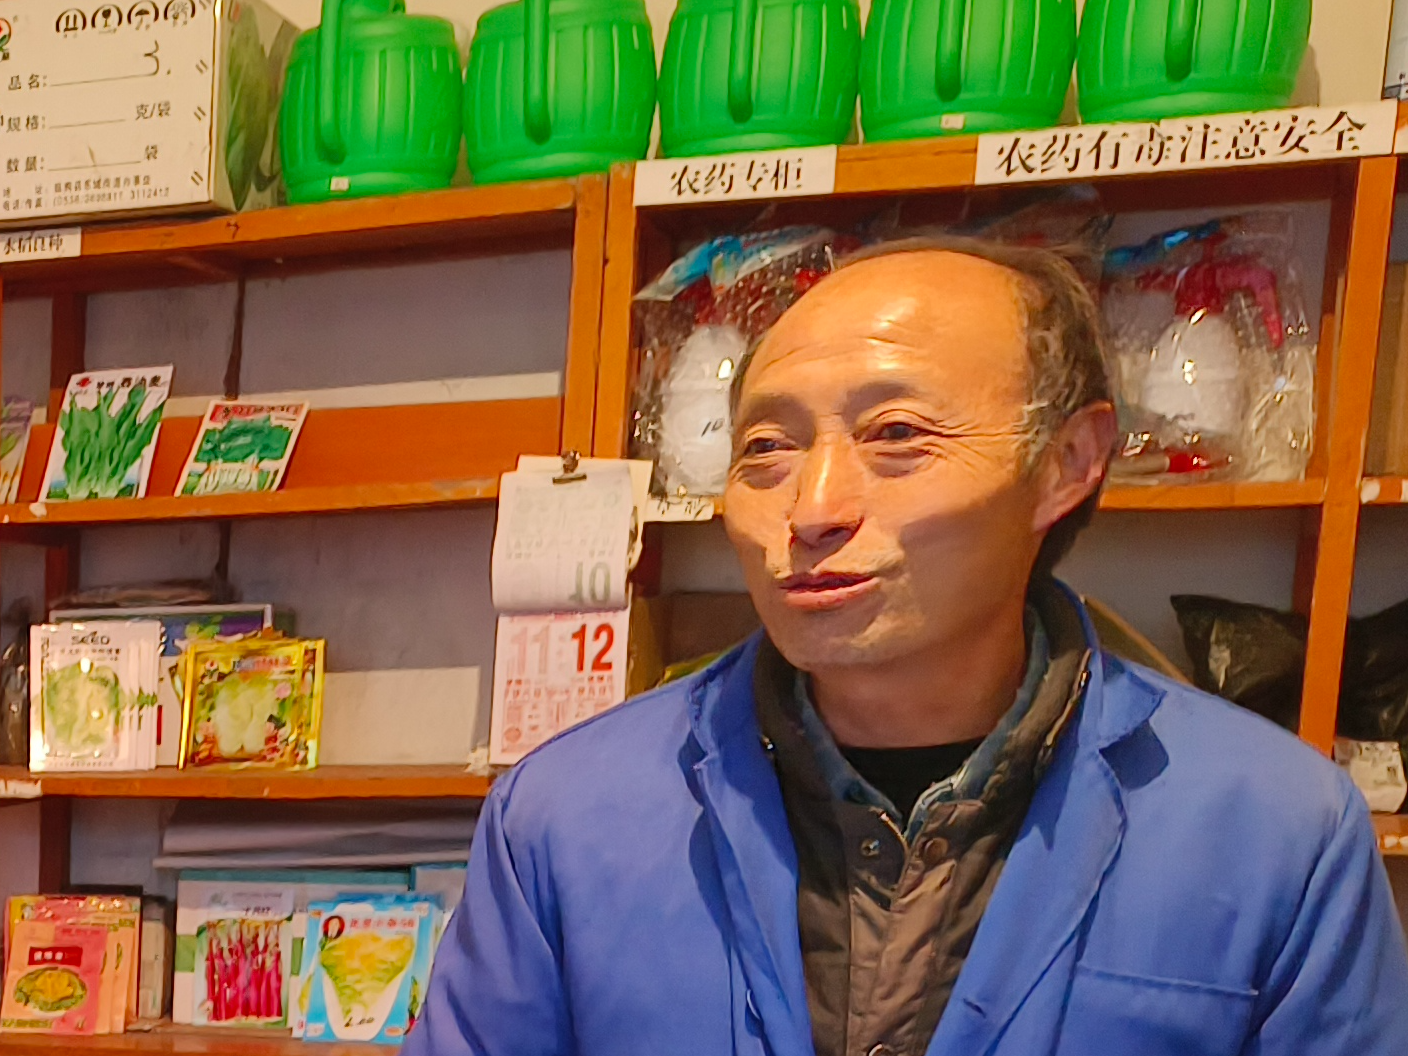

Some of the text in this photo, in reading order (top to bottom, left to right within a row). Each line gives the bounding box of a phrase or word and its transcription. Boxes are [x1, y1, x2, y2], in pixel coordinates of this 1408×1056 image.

[135, 101, 172, 120] 克/袋
[996, 111, 1367, 178] 农药有毒注意安全
[671, 156, 804, 196] 农药专柜
[572, 622, 614, 672] 12
